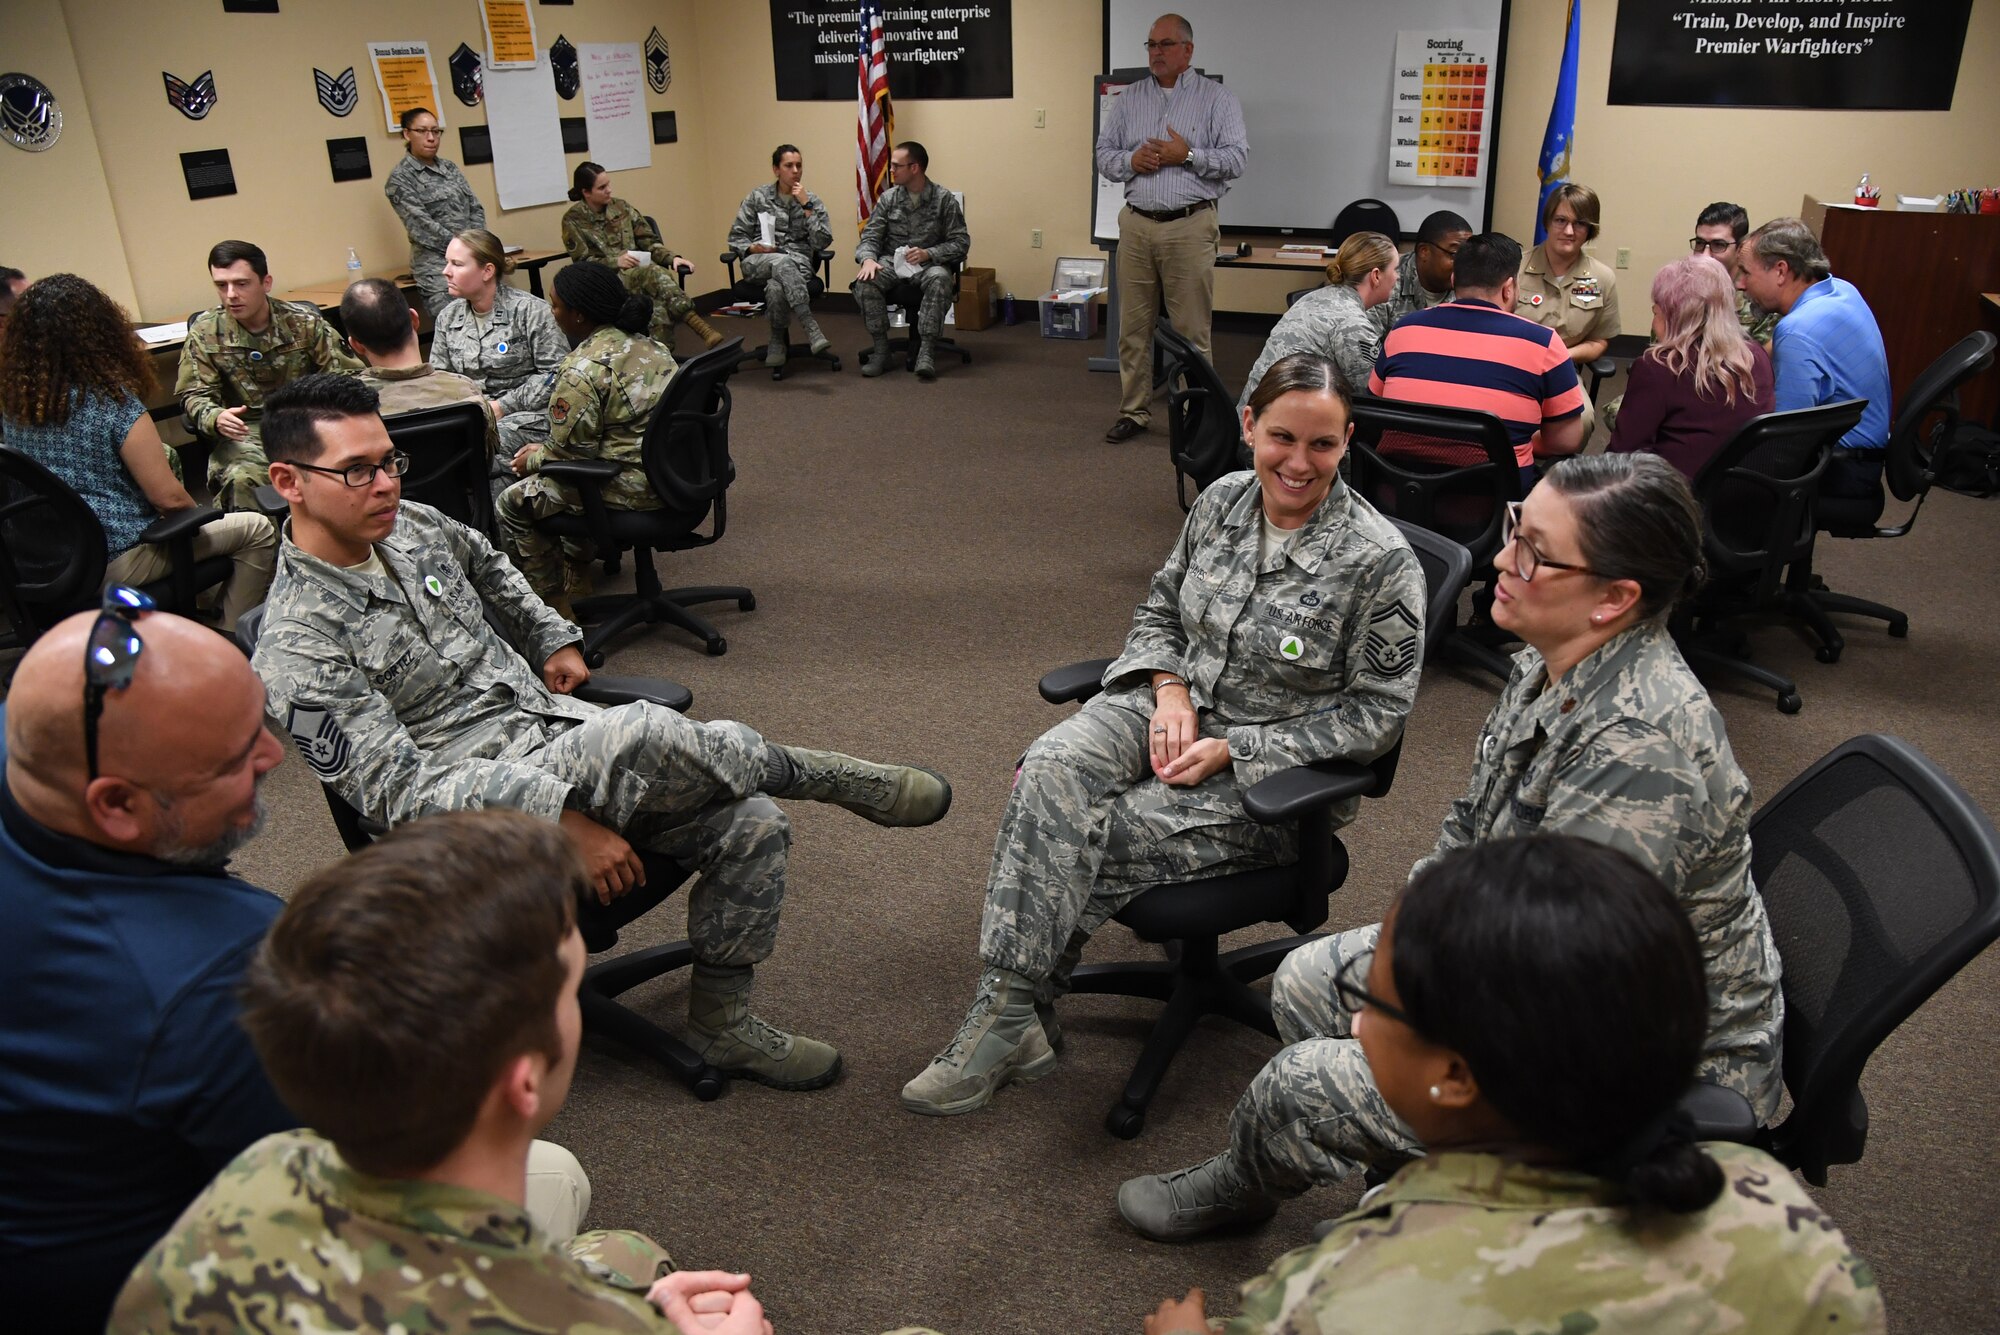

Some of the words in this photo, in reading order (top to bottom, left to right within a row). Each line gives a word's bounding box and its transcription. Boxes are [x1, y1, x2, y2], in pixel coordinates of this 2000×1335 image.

[787, 11, 815, 25] “The
[882, 8, 928, 23] training
[930, 5, 991, 22] enterprise
[1672, 12, 1730, 31] “Train,
[1734, 13, 1804, 33] Develop,
[1809, 13, 1840, 28] and
[1845, 12, 1906, 33] Inspire
[936, 27, 959, 41] and
[1427, 38, 1463, 51] Scoring
[1695, 37, 1760, 54] Premier
[1764, 38, 1874, 58] Warfighters”
[893, 47, 966, 65] warfighters”
[1401, 70, 1418, 78] Gold:
[1439, 70, 1447, 78] 16
[1450, 70, 1460, 78] 24
[1400, 93, 1421, 101] Green:
[1425, 93, 1432, 101] 4
[1449, 94, 1459, 102] 12
[1398, 115, 1413, 123] Red:
[1423, 116, 1430, 124] 3
[1397, 138, 1418, 146] White:
[1422, 139, 1429, 147] 2
[1434, 139, 1441, 147] 4
[1396, 160, 1412, 168] Blue:
[1422, 161, 1427, 169] 1
[1433, 161, 1440, 169] 2
[1444, 161, 1451, 169] 3
[1268, 605, 1284, 621] U.S.
[1284, 610, 1302, 627] AIR
[1301, 615, 1334, 632] FORCE
[376, 650, 415, 686] CORTEZ
